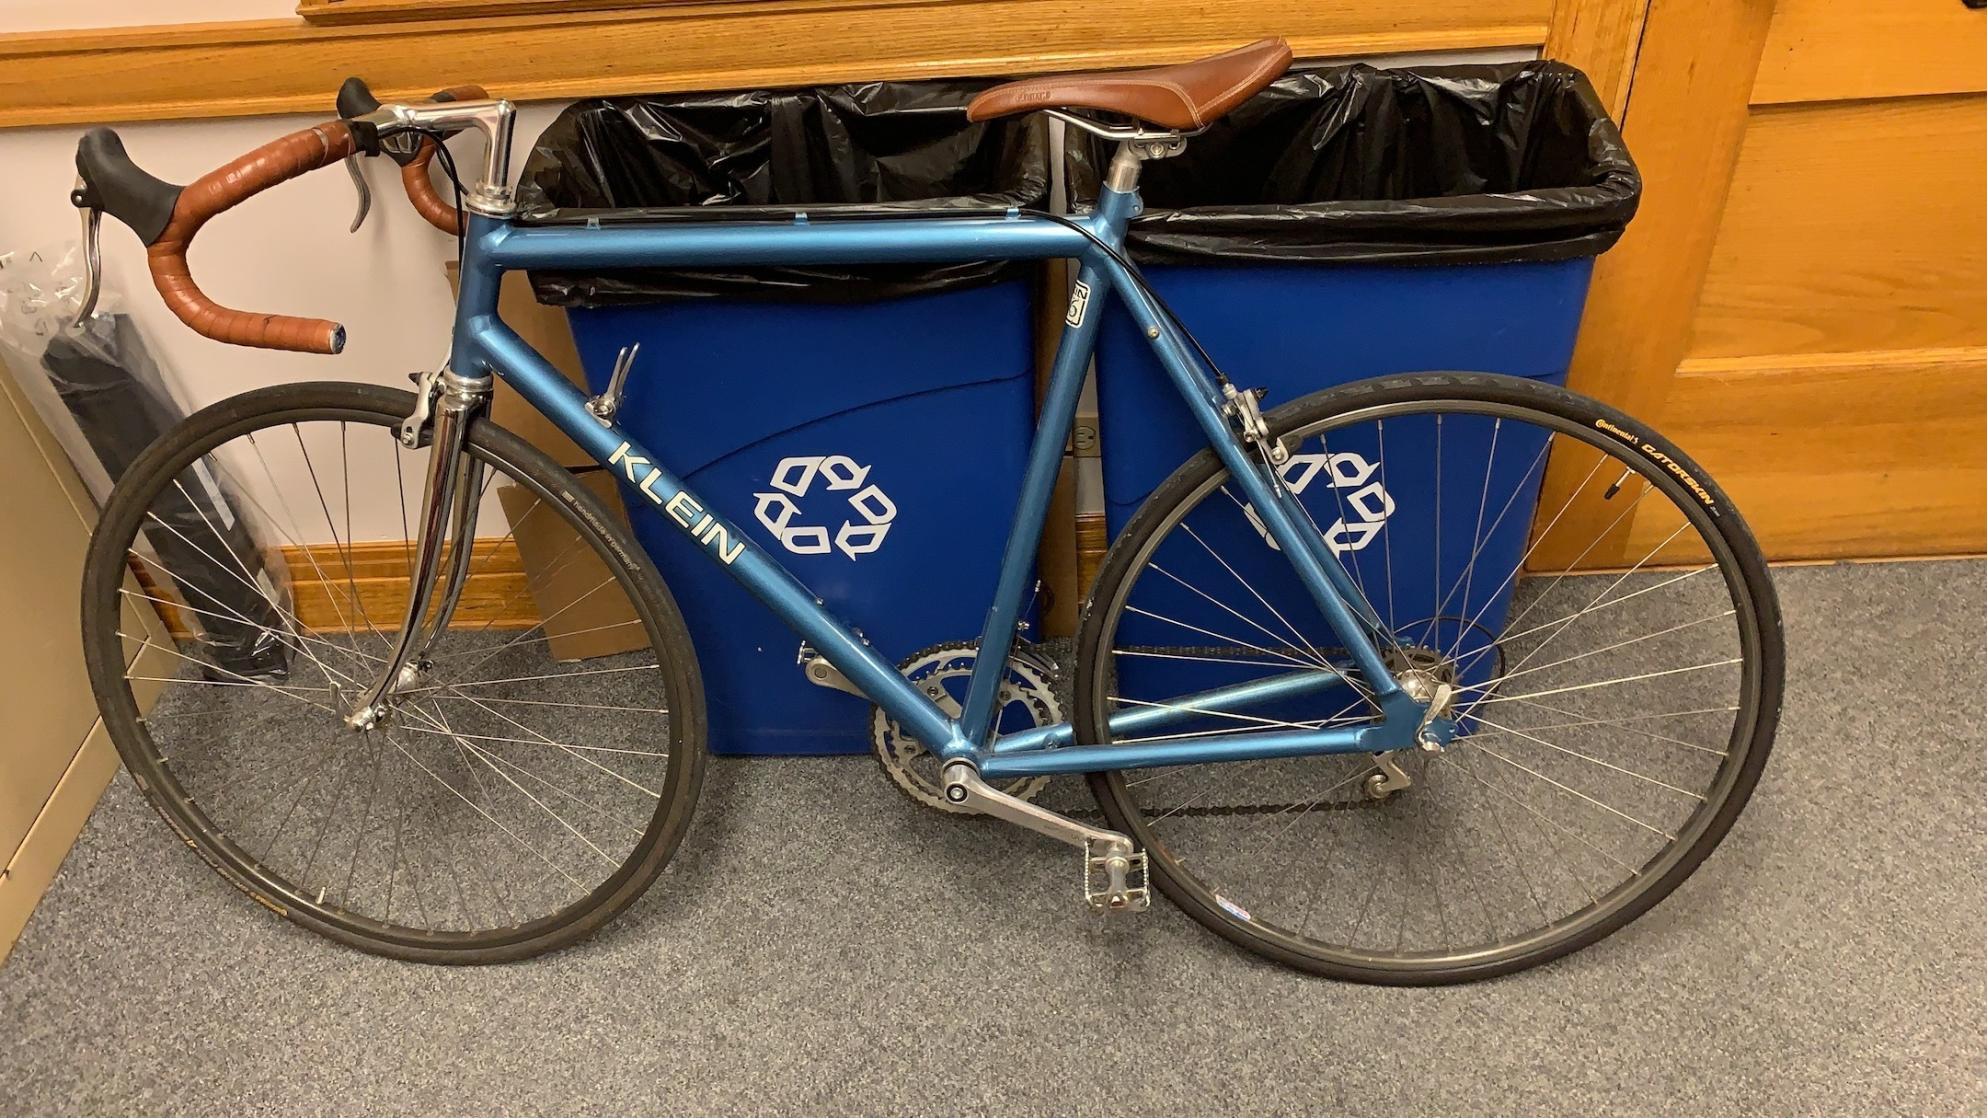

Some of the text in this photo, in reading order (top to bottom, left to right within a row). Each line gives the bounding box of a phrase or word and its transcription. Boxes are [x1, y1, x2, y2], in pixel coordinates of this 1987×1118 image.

[1595, 419, 1635, 442] Continental
[608, 441, 746, 565] KLEIN
[1641, 443, 1715, 505] GATORSKIN
